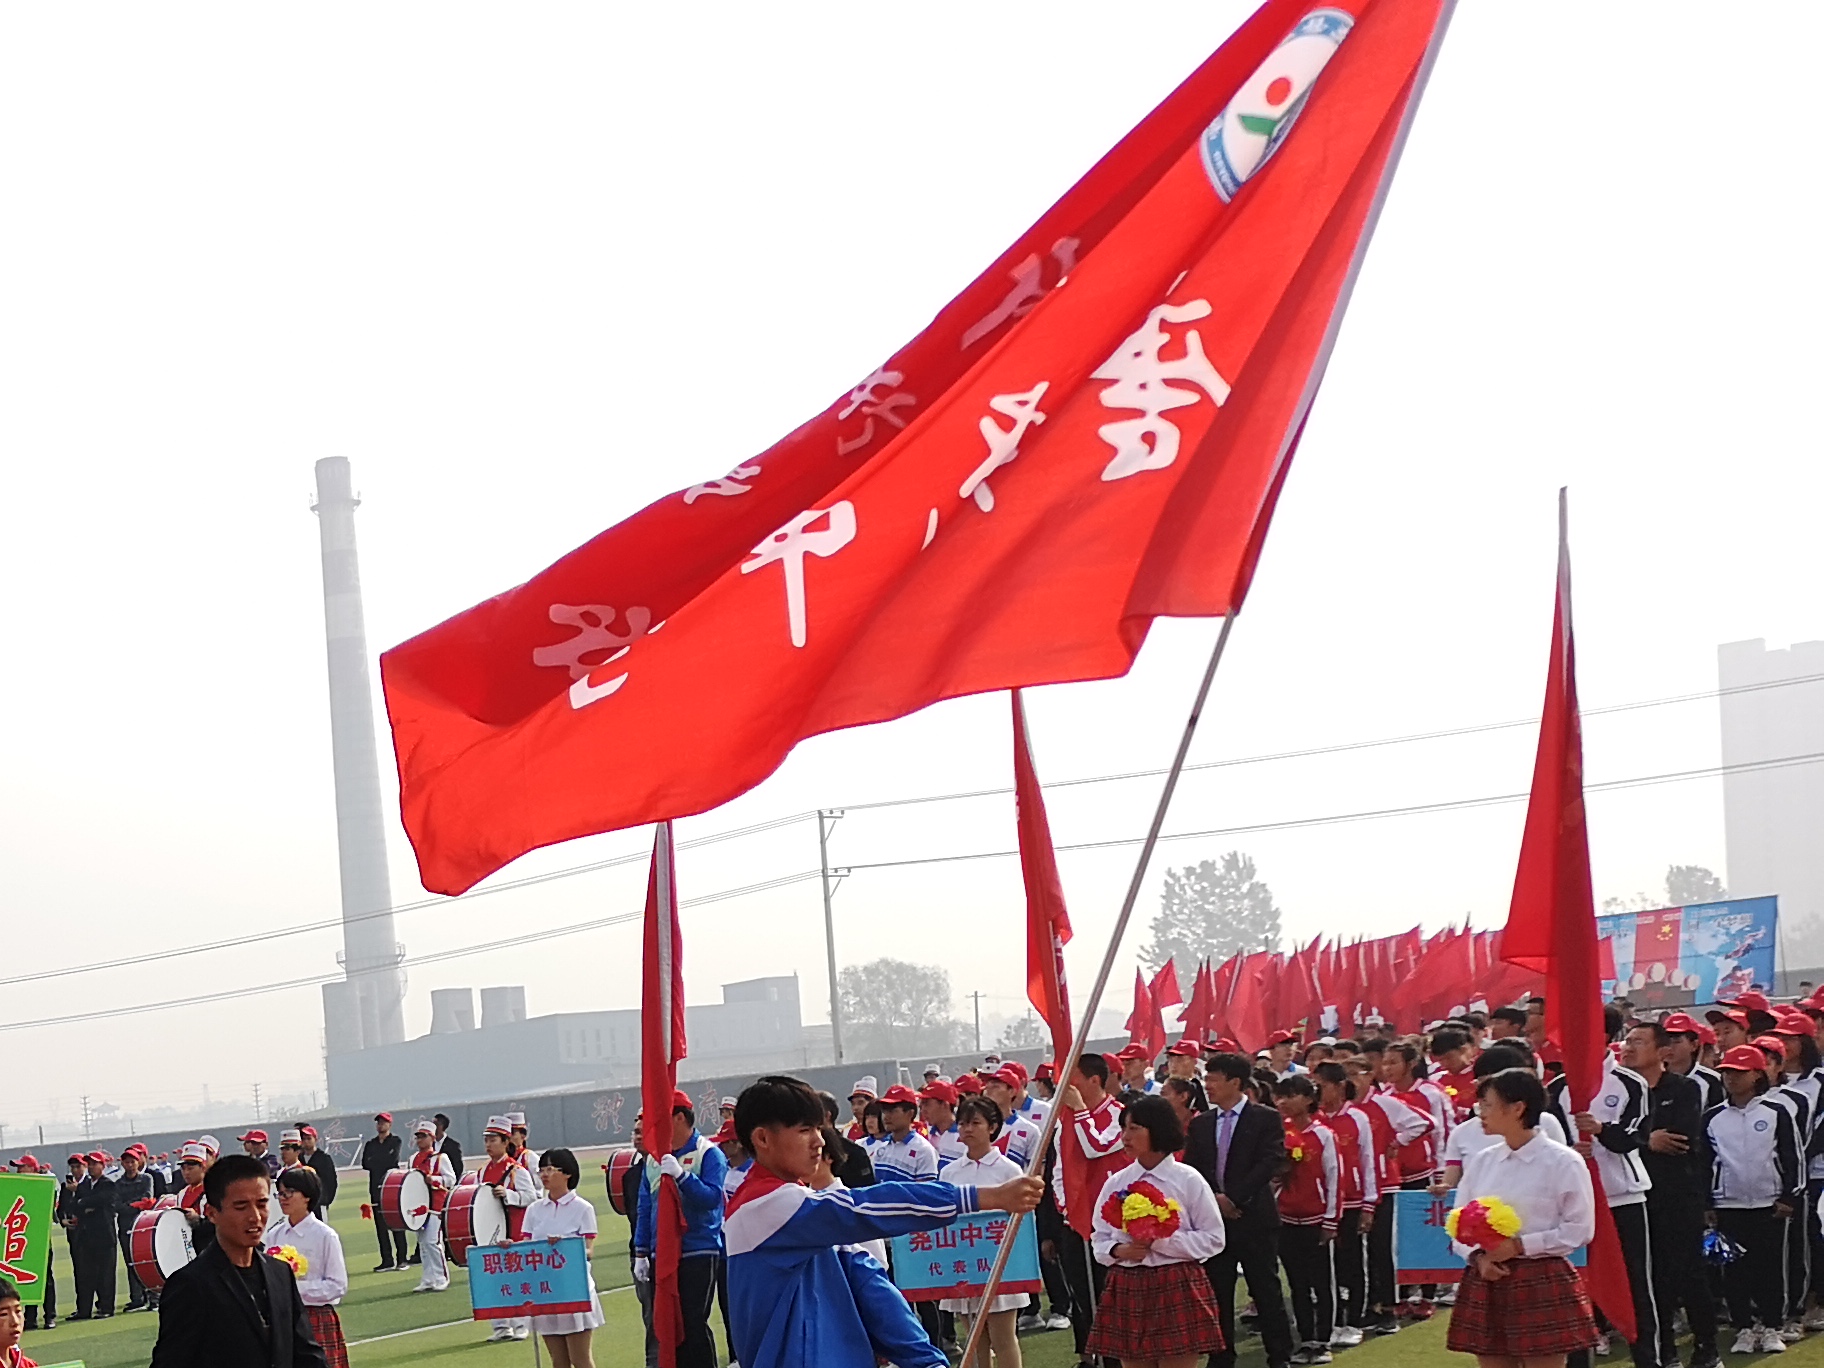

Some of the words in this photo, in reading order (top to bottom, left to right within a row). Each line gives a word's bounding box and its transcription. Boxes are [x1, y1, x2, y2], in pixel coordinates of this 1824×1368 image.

[482, 1248, 567, 1275] 职教中心
[500, 1280, 552, 1297] 代表队
